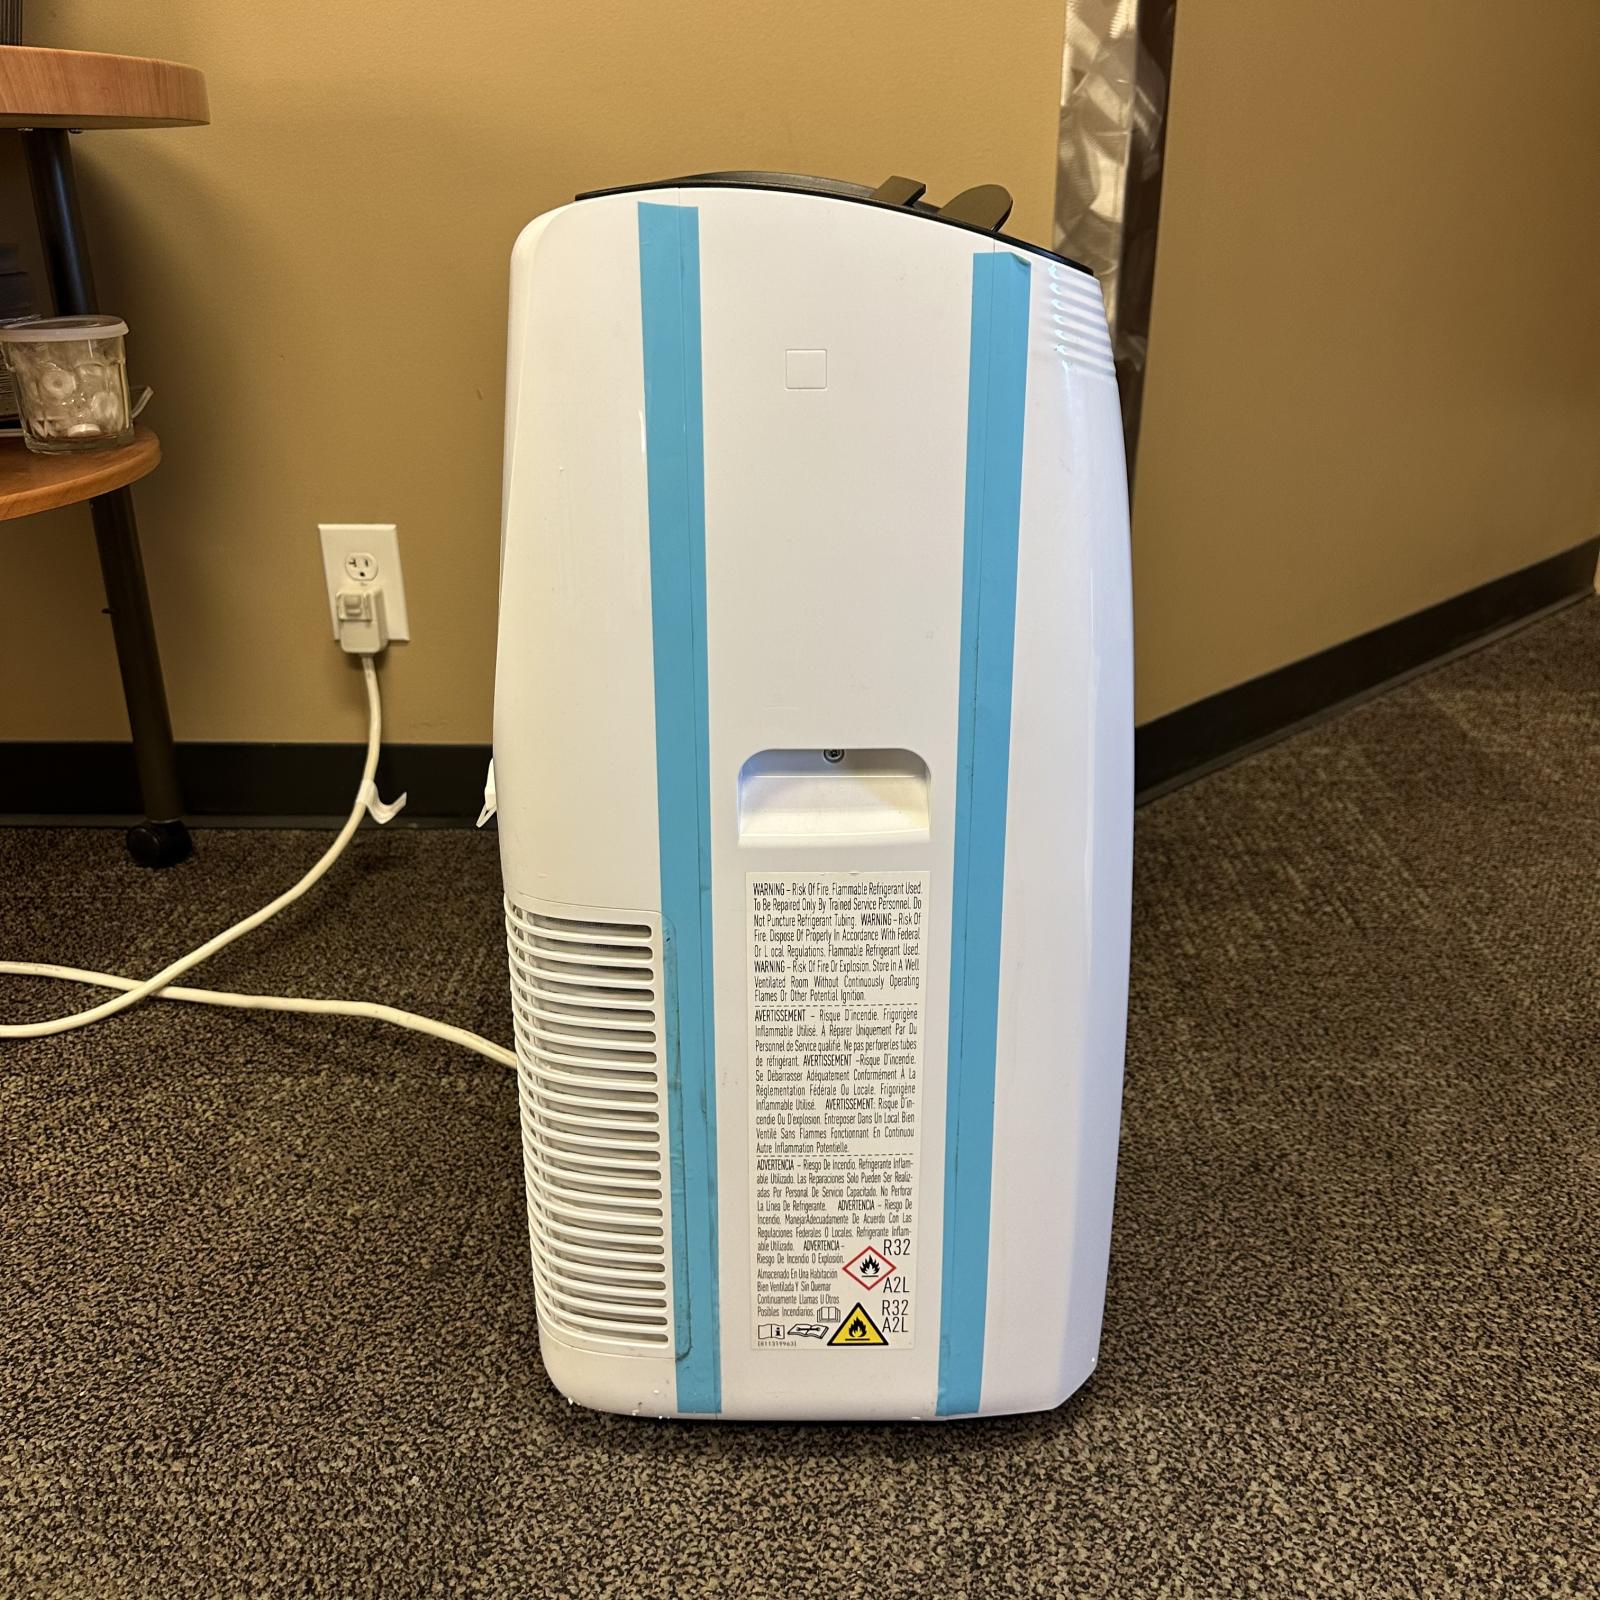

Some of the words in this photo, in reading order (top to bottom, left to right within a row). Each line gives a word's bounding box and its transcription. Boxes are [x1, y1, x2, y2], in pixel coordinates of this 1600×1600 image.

[753, 883, 785, 896] WARNING
[792, 882, 806, 895] Risk
[808, 882, 815, 895] Of
[833, 882, 867, 895] Flammable
[869, 882, 904, 898] Refrigerant
[754, 898, 761, 910] To
[763, 898, 771, 910] Be
[773, 898, 800, 913] Repaired
[802, 898, 816, 913] Only
[818, 898, 826, 913] By
[829, 898, 851, 910] Trained
[853, 897, 877, 910] Service
[914, 897, 922, 909] Do
[754, 914, 765, 926] Not
[767, 914, 795, 926] Puncture
[798, 914, 832, 929] Refrigerant
[861, 913, 892, 925] WARNING
[898, 913, 913, 925] Risk
[914, 913, 921, 925] Of
[770, 929, 794, 944] Dispose
[796, 929, 804, 941] Of
[806, 929, 831, 944] Properly
[834, 929, 840, 940] In
[842, 928, 879, 940] Accordance
[881, 928, 896, 940] With
[897, 928, 920, 940] Federal
[754, 945, 761, 957] Or
[828, 944, 863, 956] Flammable
[866, 944, 900, 959] Refrigerant
[754, 960, 785, 972] WARNING
[792, 960, 807, 972] Risk
[808, 960, 816, 972] Of
[817, 960, 829, 972] Fire
[831, 960, 838, 972] Or
[872, 959, 889, 971] Store
[891, 959, 896, 971] In
[898, 959, 903, 971] A
[905, 959, 920, 971] Well
[754, 976, 786, 988] Ventilated
[791, 976, 809, 988] Room
[814, 976, 839, 987] Without
[844, 975, 884, 990] Continuously
[889, 975, 919, 989] Operating
[754, 990, 778, 1001] Flames
[780, 990, 787, 1001] Or
[790, 990, 807, 1001] Other
[810, 990, 838, 1001] Potential
[755, 1009, 805, 1021] AVERTISSEMENT
[819, 1009, 840, 1024] Risque
[755, 1025, 793, 1036] Inflammable
[856, 1024, 892, 1038] Uniquement
[895, 1023, 906, 1035] Par
[909, 1023, 917, 1035] Du
[756, 1040, 785, 1051] Personnel
[787, 1040, 794, 1051] de
[794, 1039, 816, 1051] Service
[844, 1039, 852, 1050] Ne
[854, 1041, 864, 1053] pas
[900, 1038, 916, 1049] tubes
[756, 1055, 763, 1066] de
[803, 1054, 852, 1066] AVERTISSEMENT
[756, 1070, 763, 1081] Se
[909, 1068, 916, 1079] La
[840, 1084, 849, 1095] Ou
[878, 1098, 898, 1111] Risque
[756, 1114, 776, 1125] cendie
[778, 1114, 786, 1125] Ou
[824, 1113, 856, 1127] Entreposer
[858, 1113, 872, 1124] Dans
[874, 1113, 882, 1123] Un
[884, 1112, 900, 1123] Local
[901, 1112, 914, 1123] Bien
[781, 1128, 795, 1139] Sans
[800, 1127, 826, 1138] Flammes
[831, 1127, 869, 1138] Fonctionnant
[873, 1127, 880, 1138] En
[774, 1142, 814, 1153] Inflammation
[883, 1239, 910, 1256] R32
[883, 1277, 910, 1293] A2L
[882, 1300, 909, 1316] R32
[882, 1317, 908, 1333] A2L
